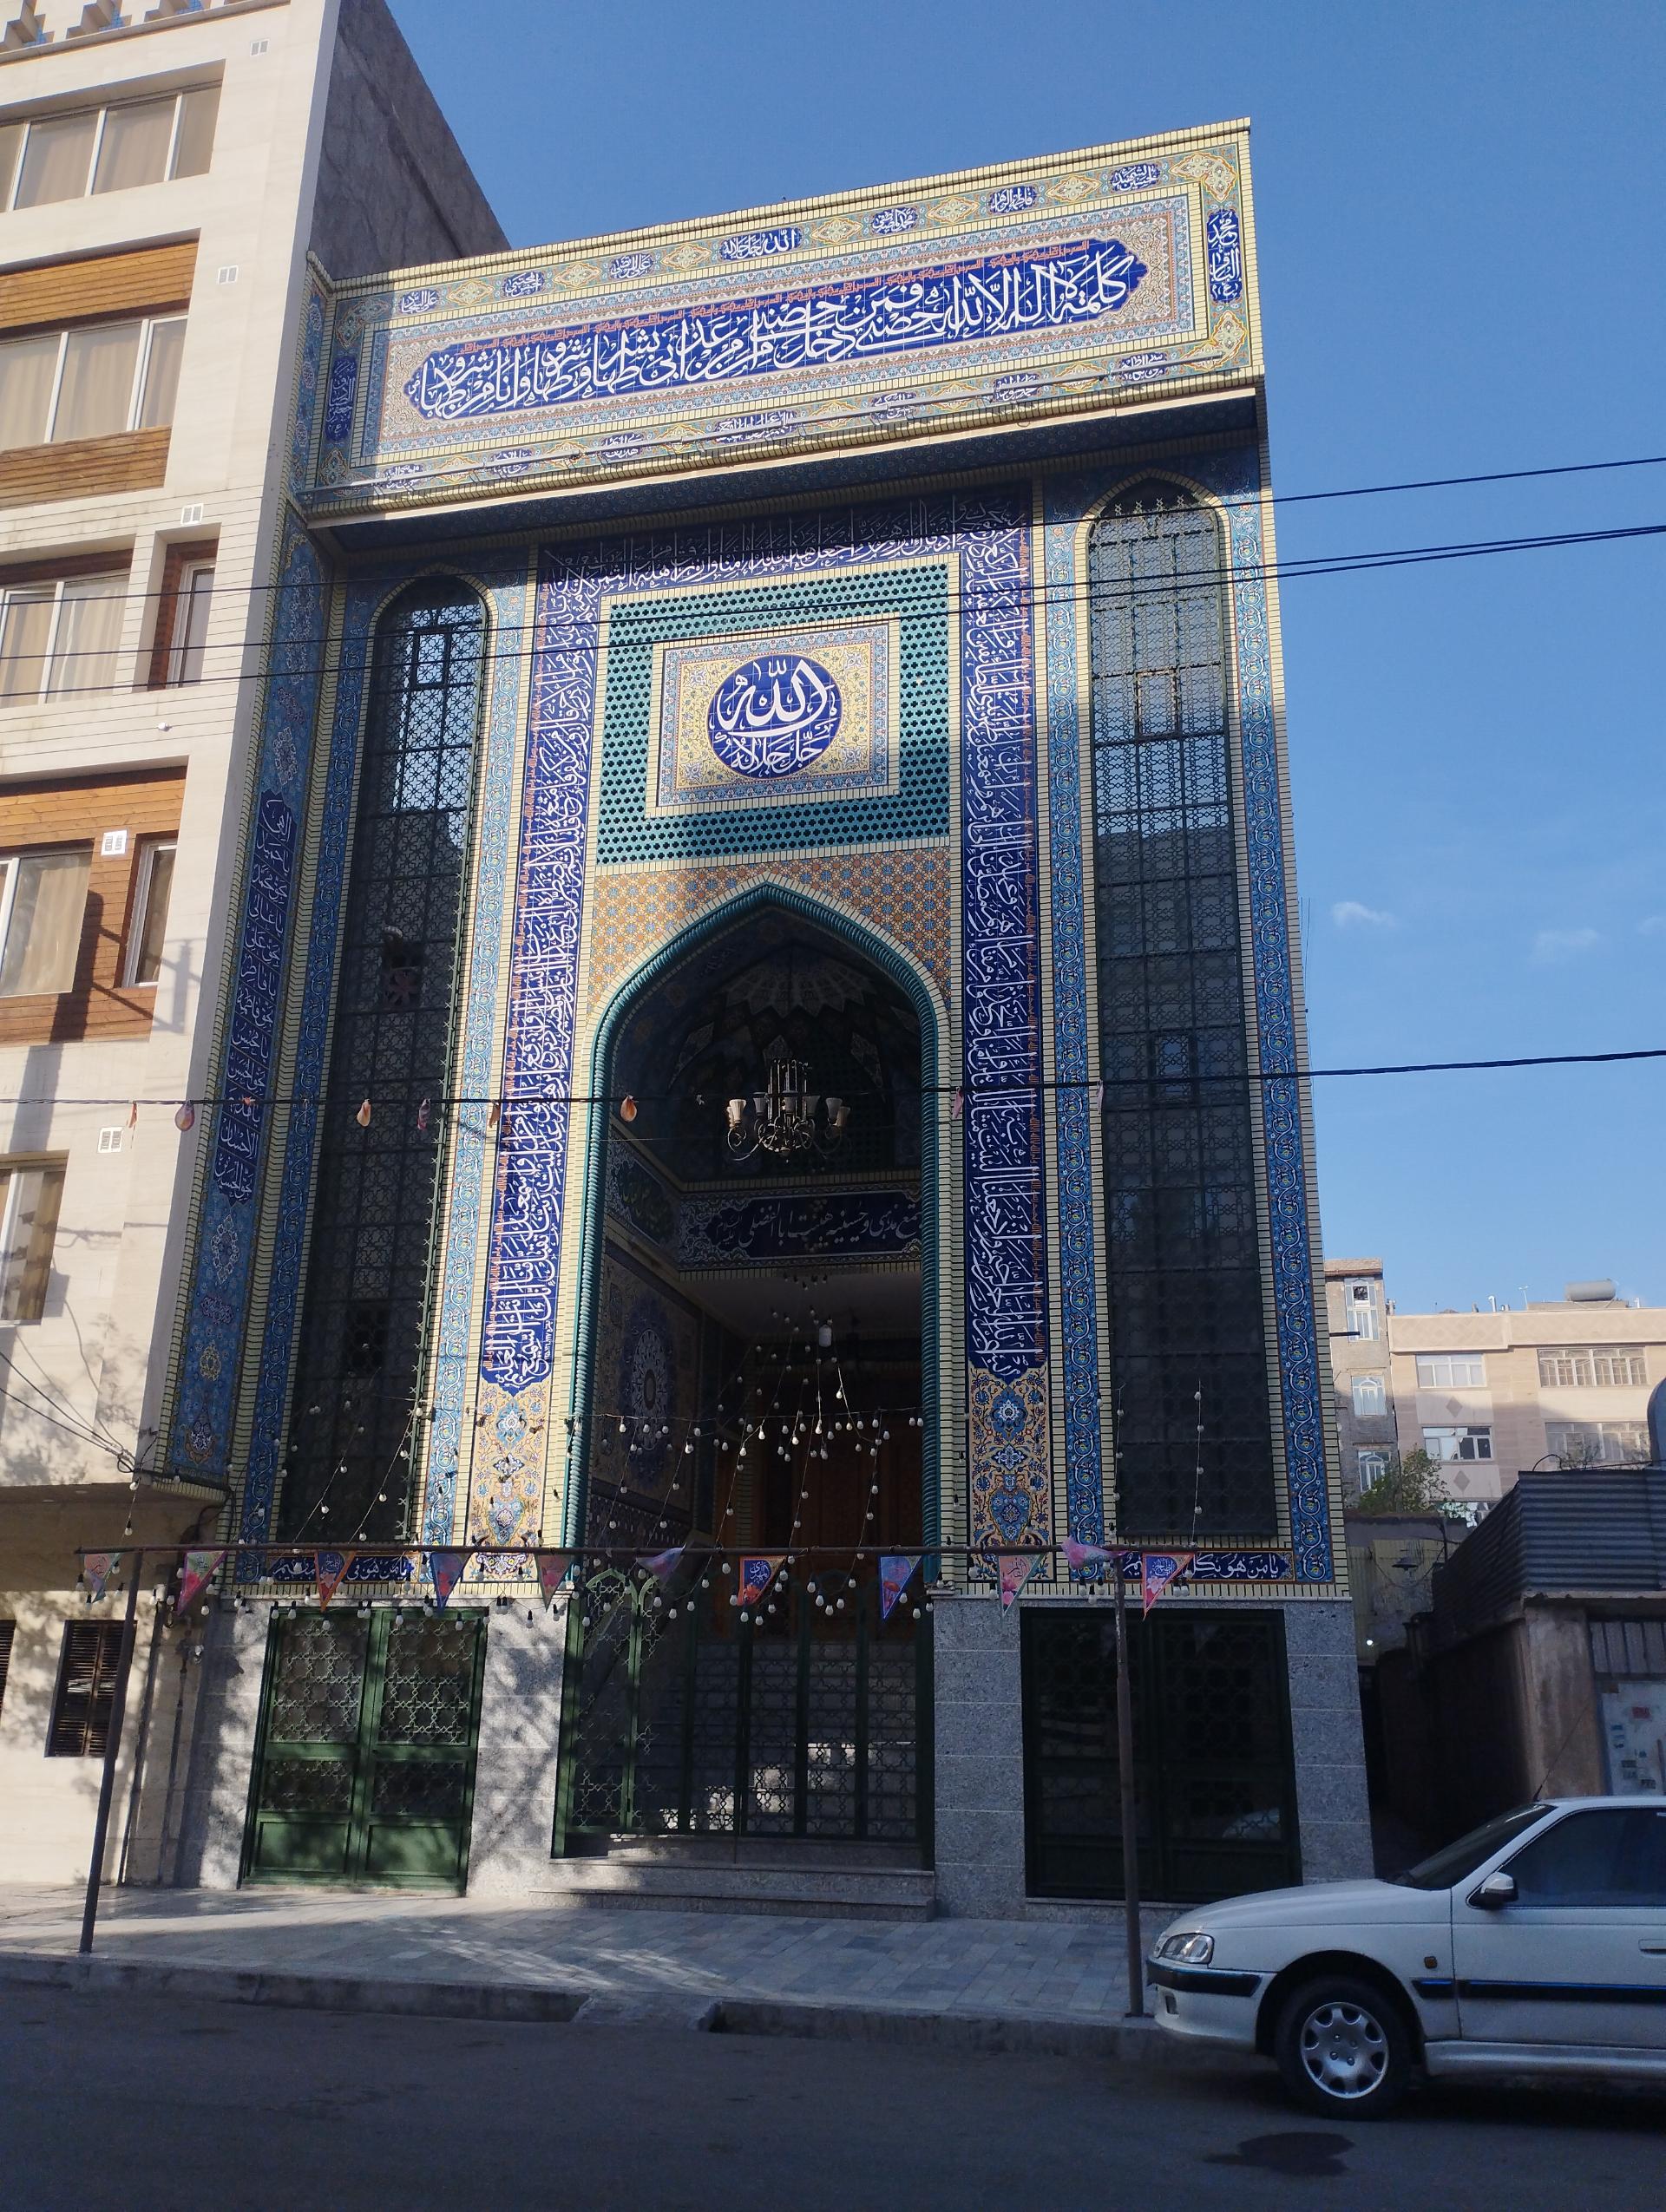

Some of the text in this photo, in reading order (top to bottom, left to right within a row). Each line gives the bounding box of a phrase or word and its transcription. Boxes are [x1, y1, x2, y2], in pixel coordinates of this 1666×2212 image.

[764, 228, 797, 254] الله
[1208, 217, 1238, 247] محمد
[1209, 245, 1240, 282] الباقر
[930, 274, 984, 340] الله
[717, 658, 830, 776] الله جل جلاله
[966, 949, 993, 983] من
[971, 1128, 1040, 1181] البيت
[981, 1178, 1041, 1230] جعلنا
[485, 1321, 550, 1384] السميع
